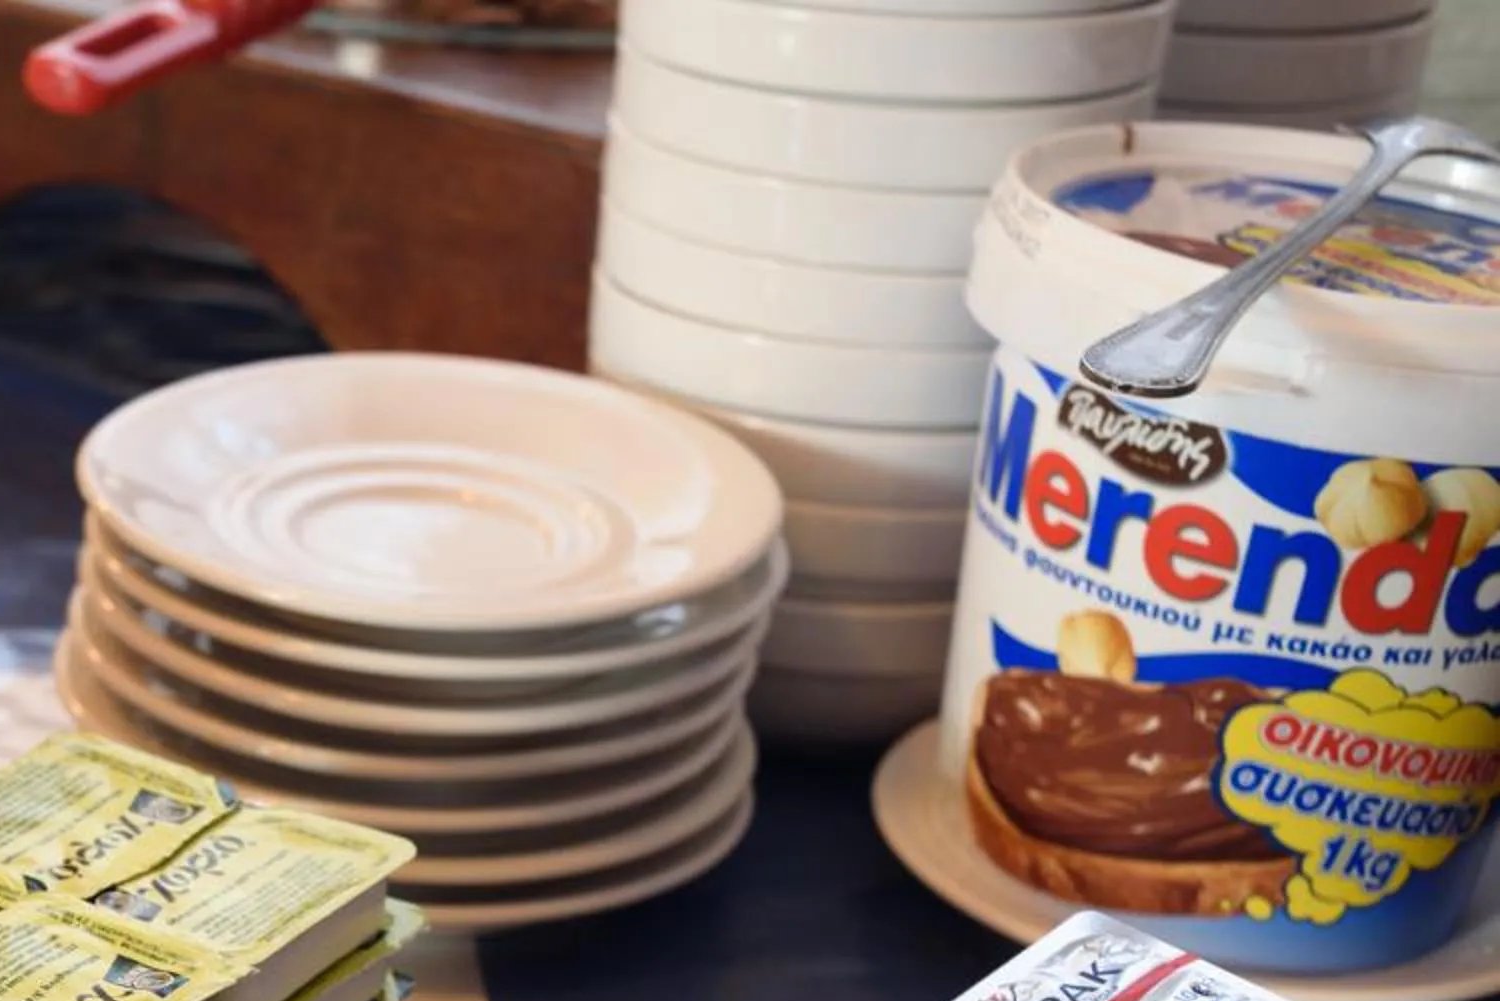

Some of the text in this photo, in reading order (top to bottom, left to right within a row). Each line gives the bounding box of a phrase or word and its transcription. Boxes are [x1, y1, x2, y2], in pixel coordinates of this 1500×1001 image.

[1212, 621, 1254, 645] με
[1266, 631, 1373, 662] κακάο
[1383, 645, 1433, 666] και
